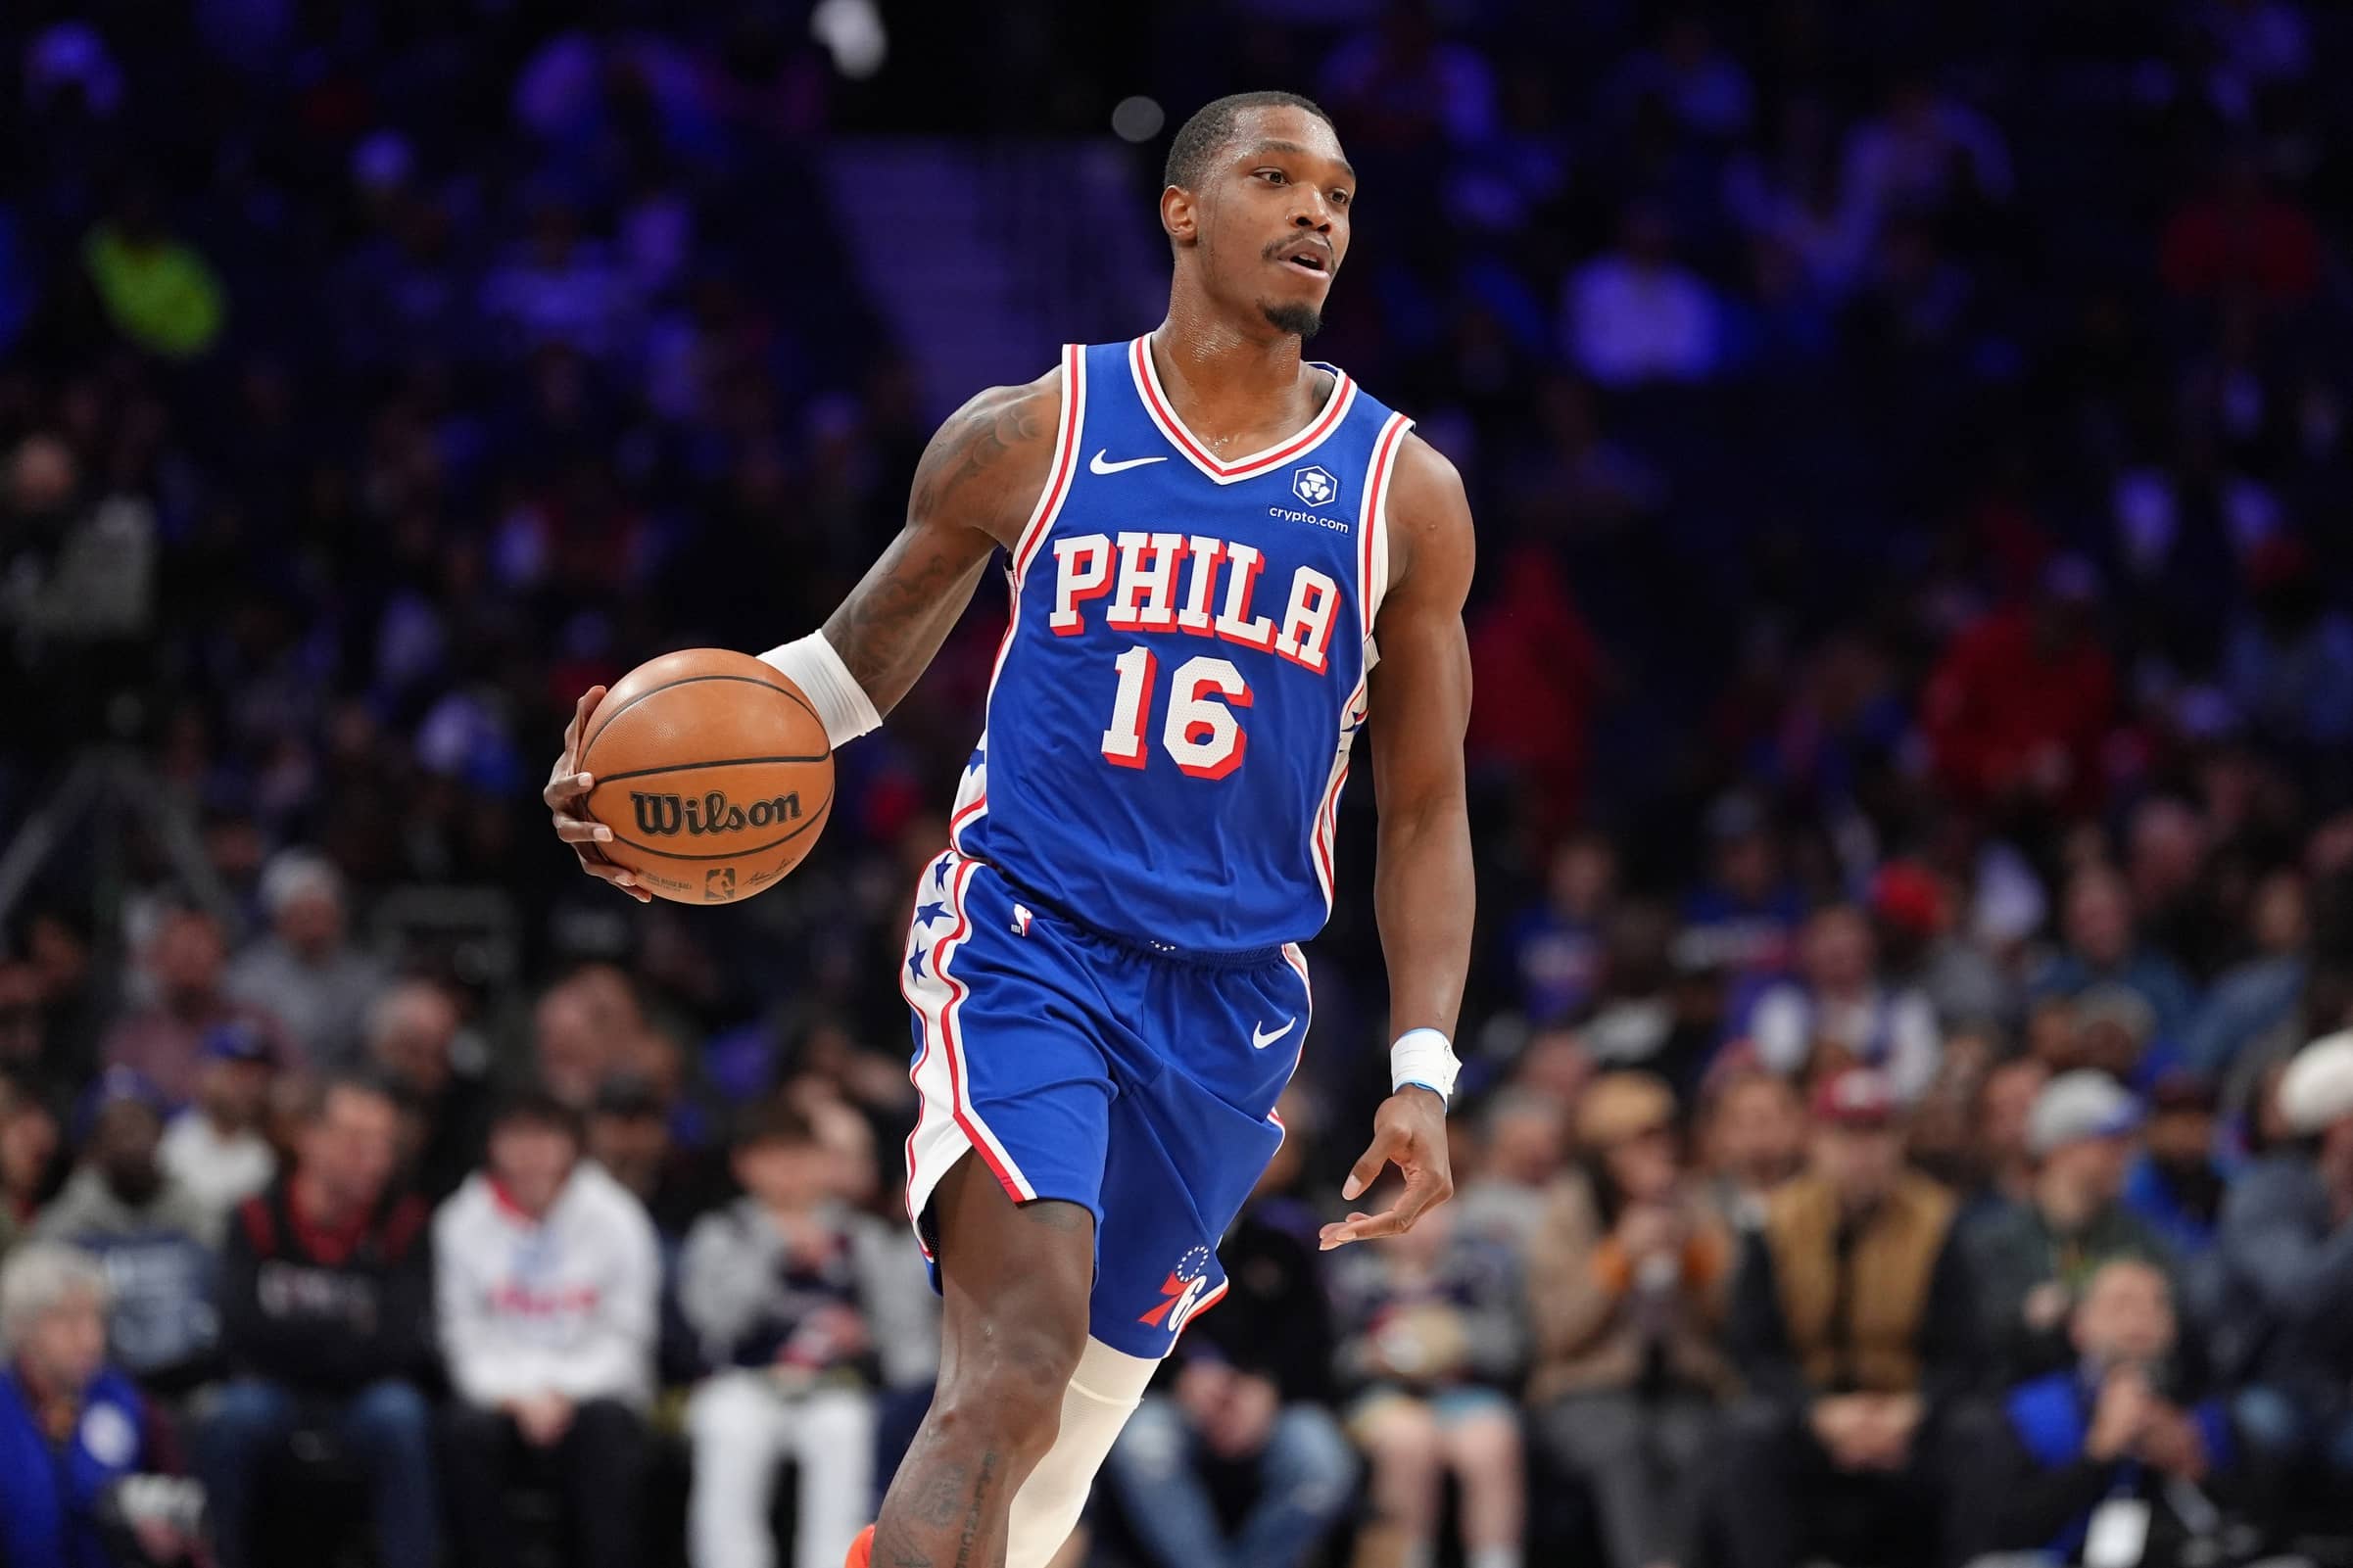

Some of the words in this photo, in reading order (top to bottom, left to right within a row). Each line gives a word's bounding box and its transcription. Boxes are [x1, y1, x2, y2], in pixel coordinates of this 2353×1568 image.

[1269, 507, 1349, 534] crypto.com
[1049, 532, 1341, 676] PHILA
[1101, 645, 1254, 781] 16
[630, 790, 801, 836] Wilson
